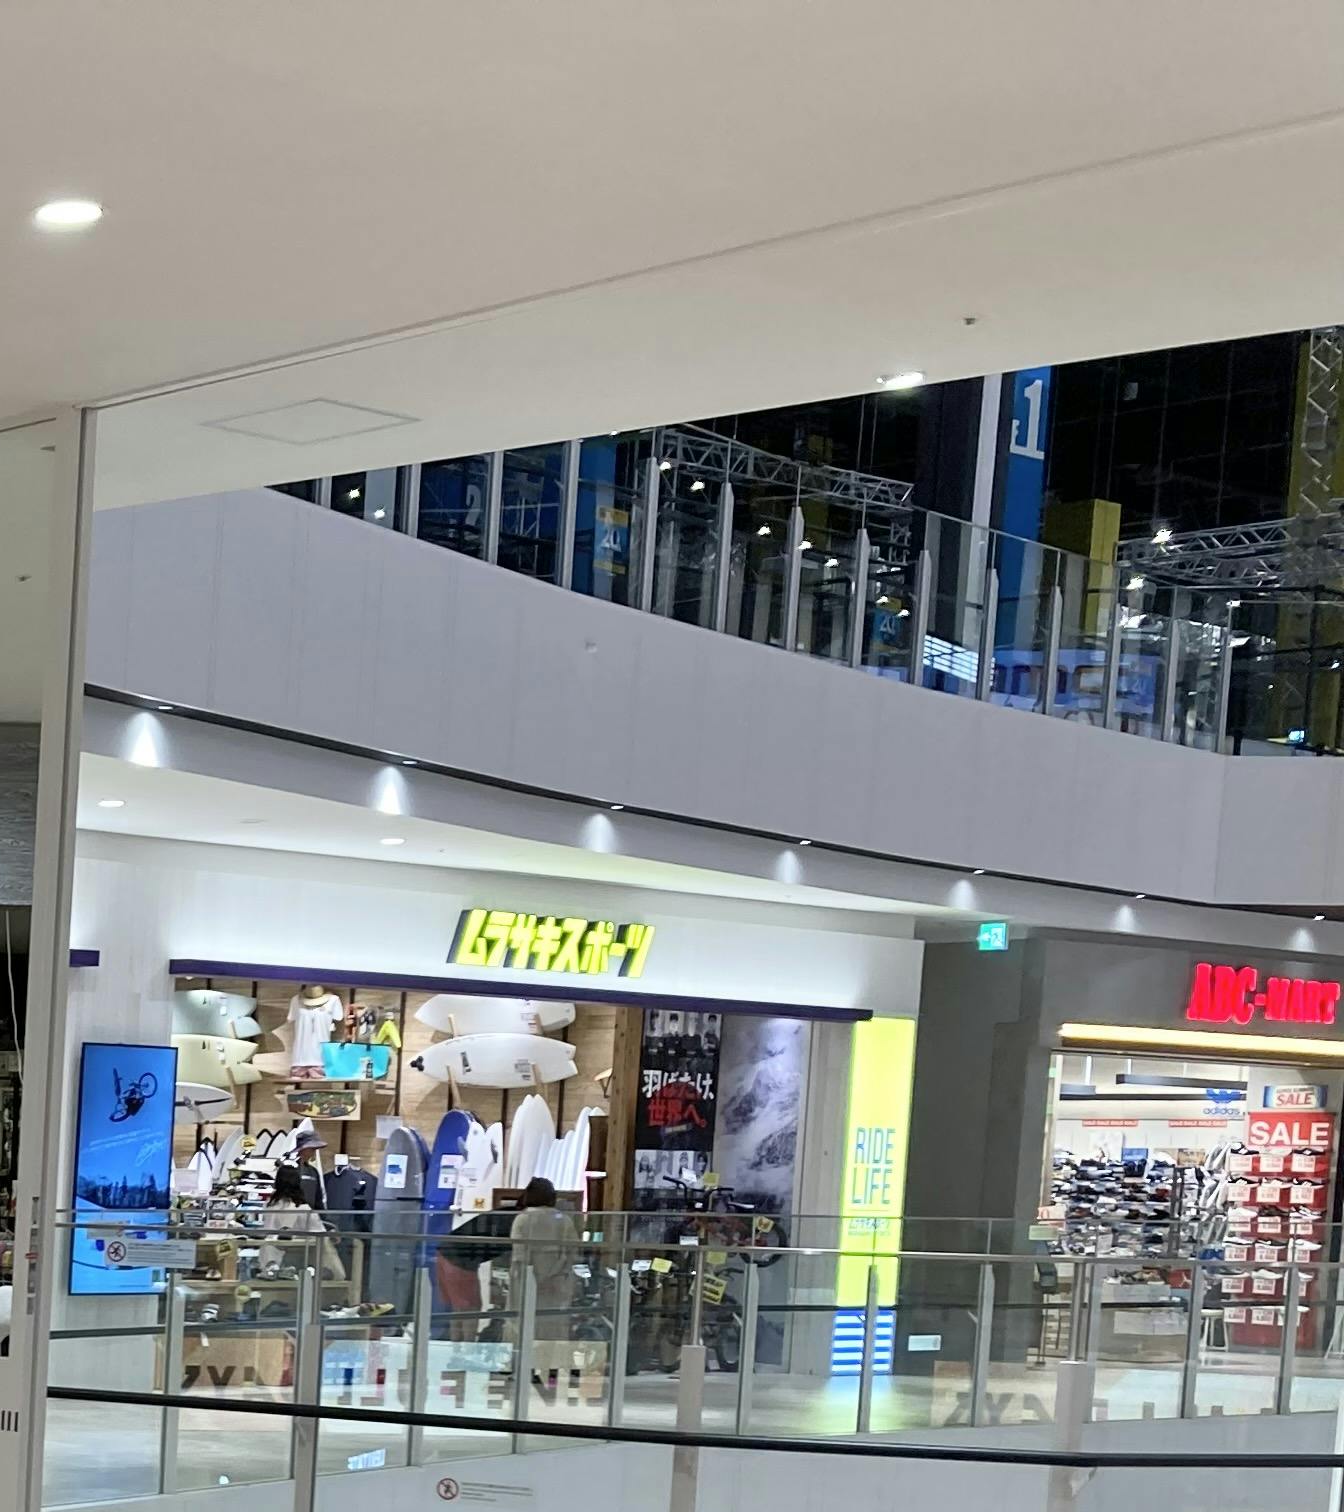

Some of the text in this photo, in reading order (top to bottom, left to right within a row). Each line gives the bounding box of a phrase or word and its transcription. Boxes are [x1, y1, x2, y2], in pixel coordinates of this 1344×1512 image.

[450, 909, 655, 978] ムラサキスポーツ
[1186, 962, 1341, 1025] ABC-MART
[1202, 1106, 1241, 1116] adidas
[1276, 1092, 1313, 1106] SALE
[854, 1127, 896, 1164] RIDE
[1249, 1120, 1330, 1147] SALE
[851, 1167, 893, 1204] LIFE
